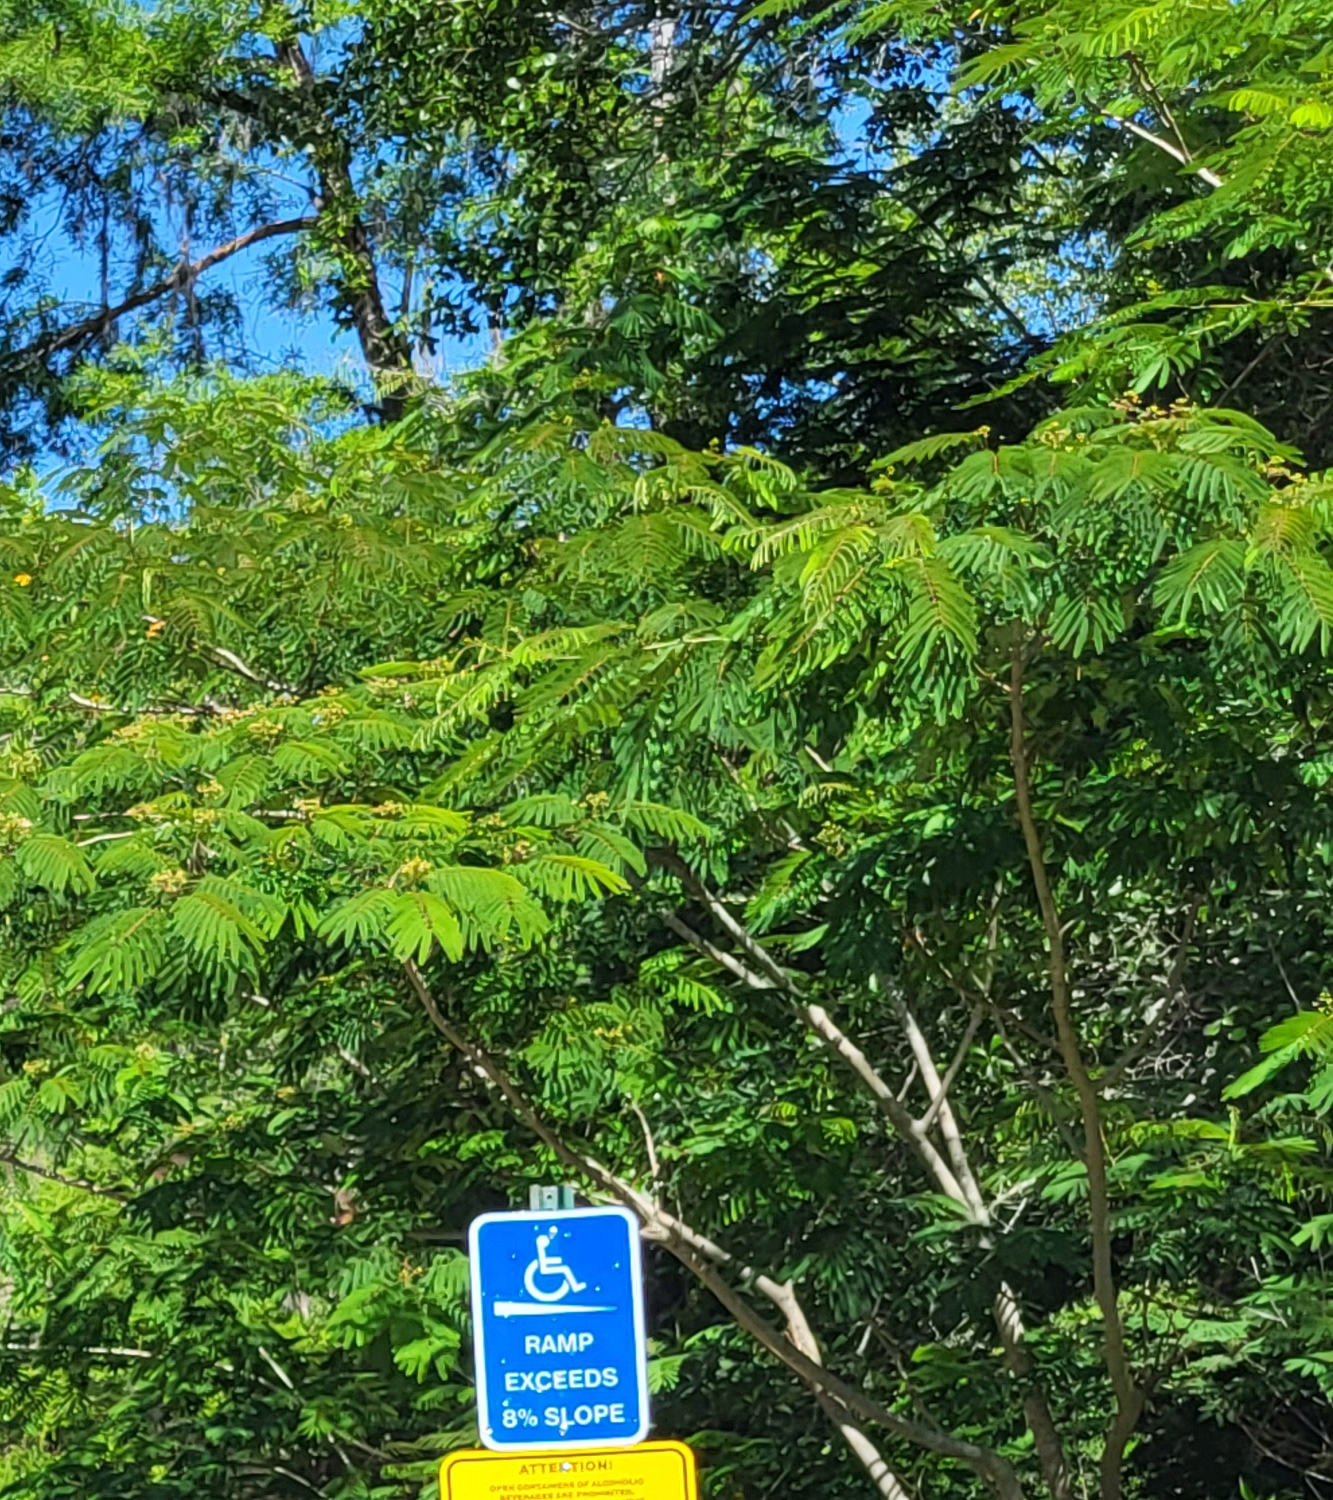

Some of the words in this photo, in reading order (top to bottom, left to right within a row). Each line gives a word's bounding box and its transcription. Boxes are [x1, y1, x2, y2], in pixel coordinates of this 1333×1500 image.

[525, 1332, 594, 1354] RAMP
[505, 1367, 619, 1392] EXCEEDS
[502, 1408, 539, 1428] 8%
[544, 1403, 625, 1428] SLOPE
[577, 1480, 589, 1488] OF
[591, 1477, 645, 1487] ALCOHOLIC
[556, 1491, 573, 1499] ARE
